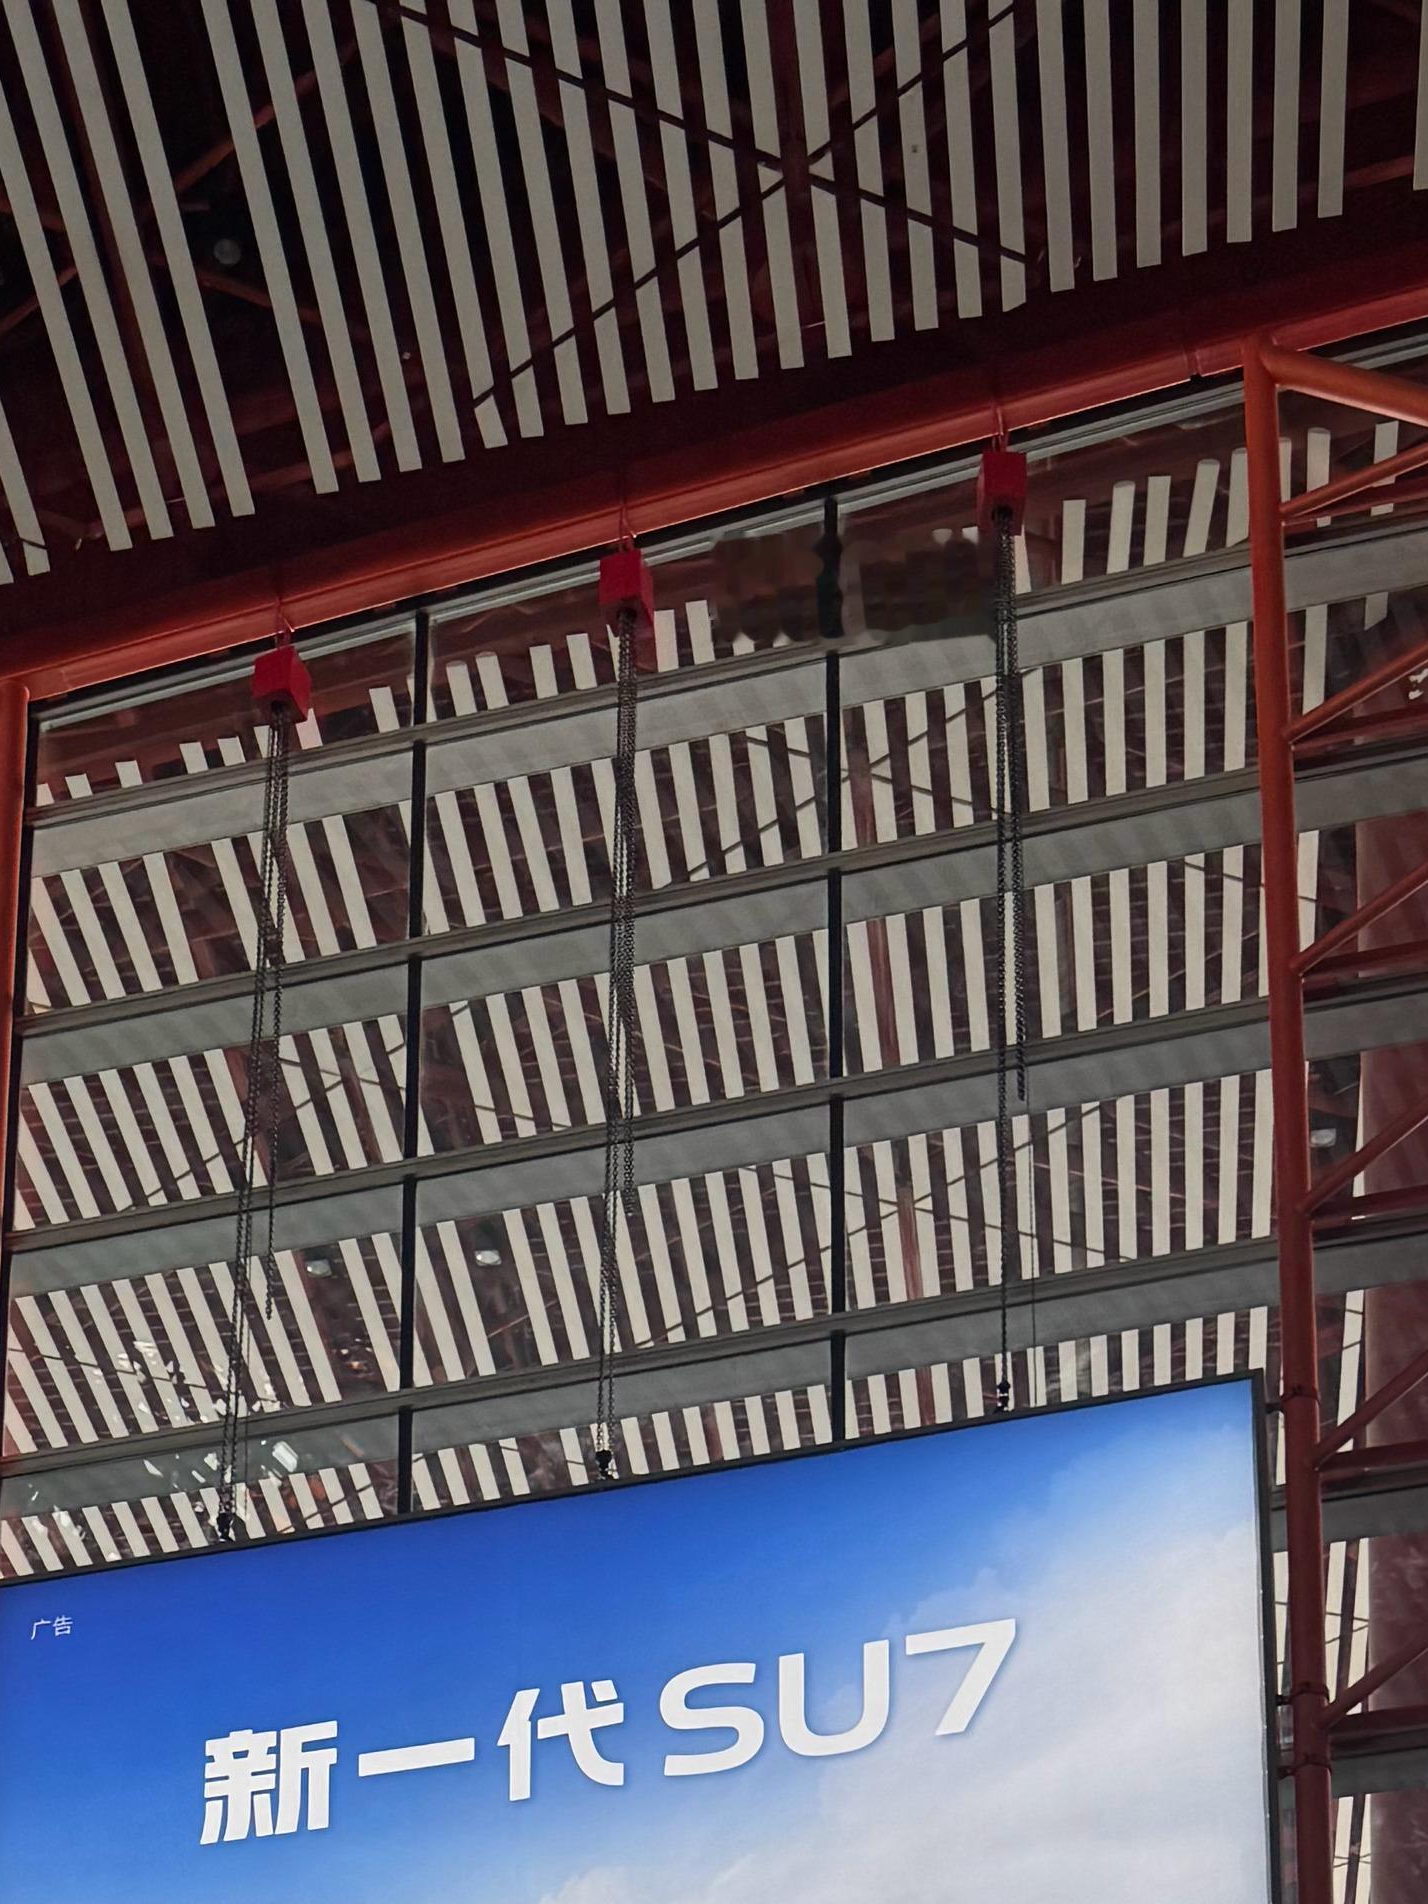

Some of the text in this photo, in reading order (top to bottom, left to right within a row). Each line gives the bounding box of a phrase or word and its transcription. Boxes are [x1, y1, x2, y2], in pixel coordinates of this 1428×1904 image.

[31, 1615, 73, 1640] 广告
[199, 1617, 1016, 1845] 新一代 SU7
